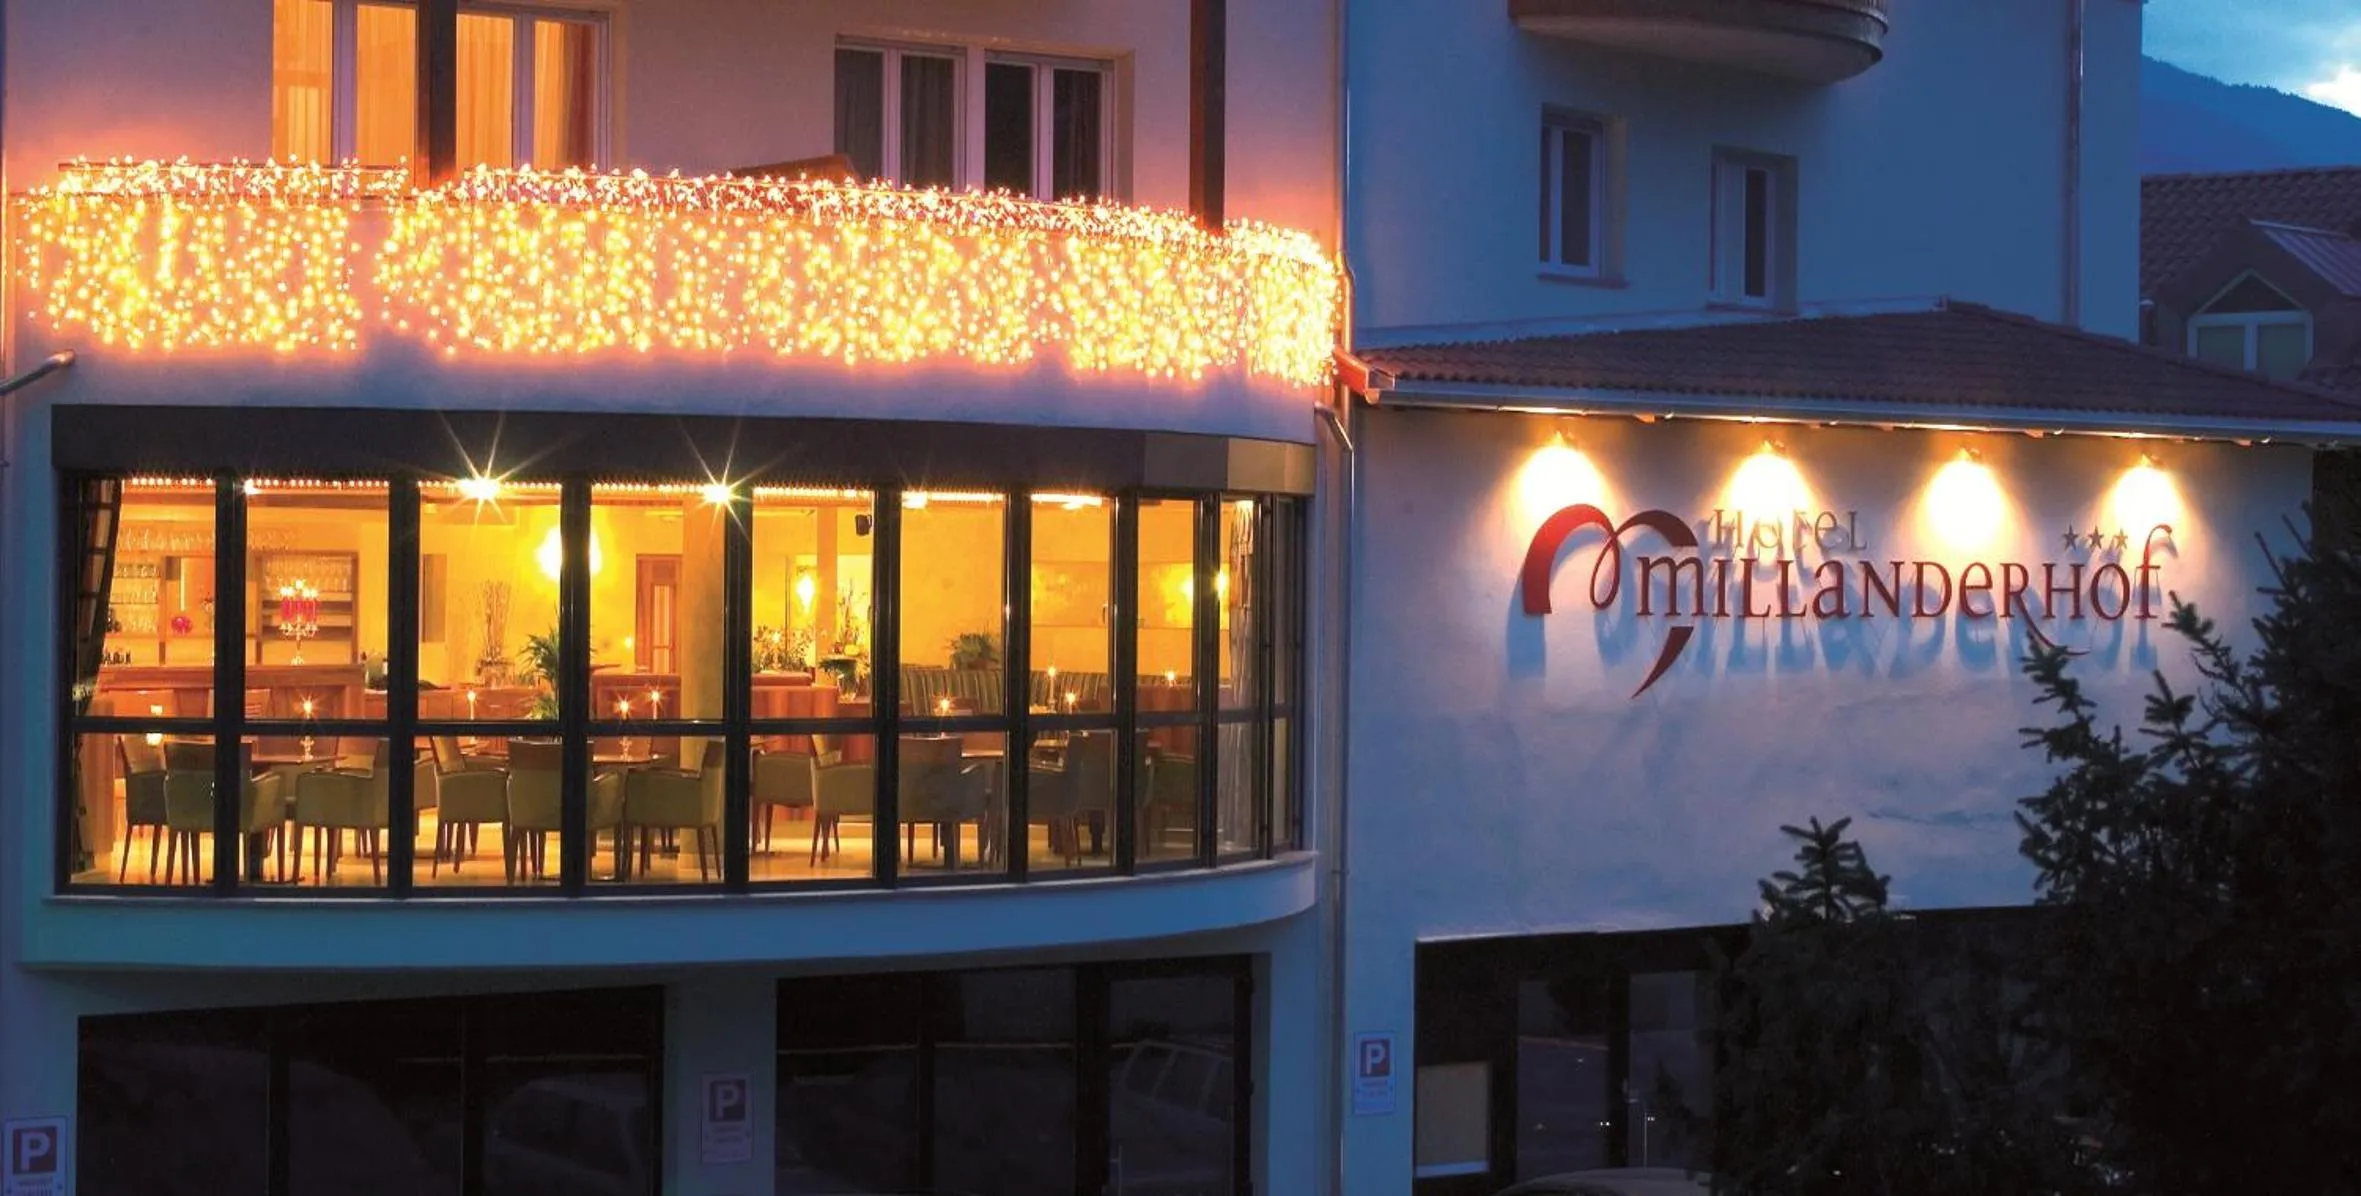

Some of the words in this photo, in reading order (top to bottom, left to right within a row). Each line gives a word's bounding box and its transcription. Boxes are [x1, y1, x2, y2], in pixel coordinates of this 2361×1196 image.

[1365, 1043, 1386, 1075] P
[716, 1084, 740, 1119] P
[20, 1131, 51, 1171] P
